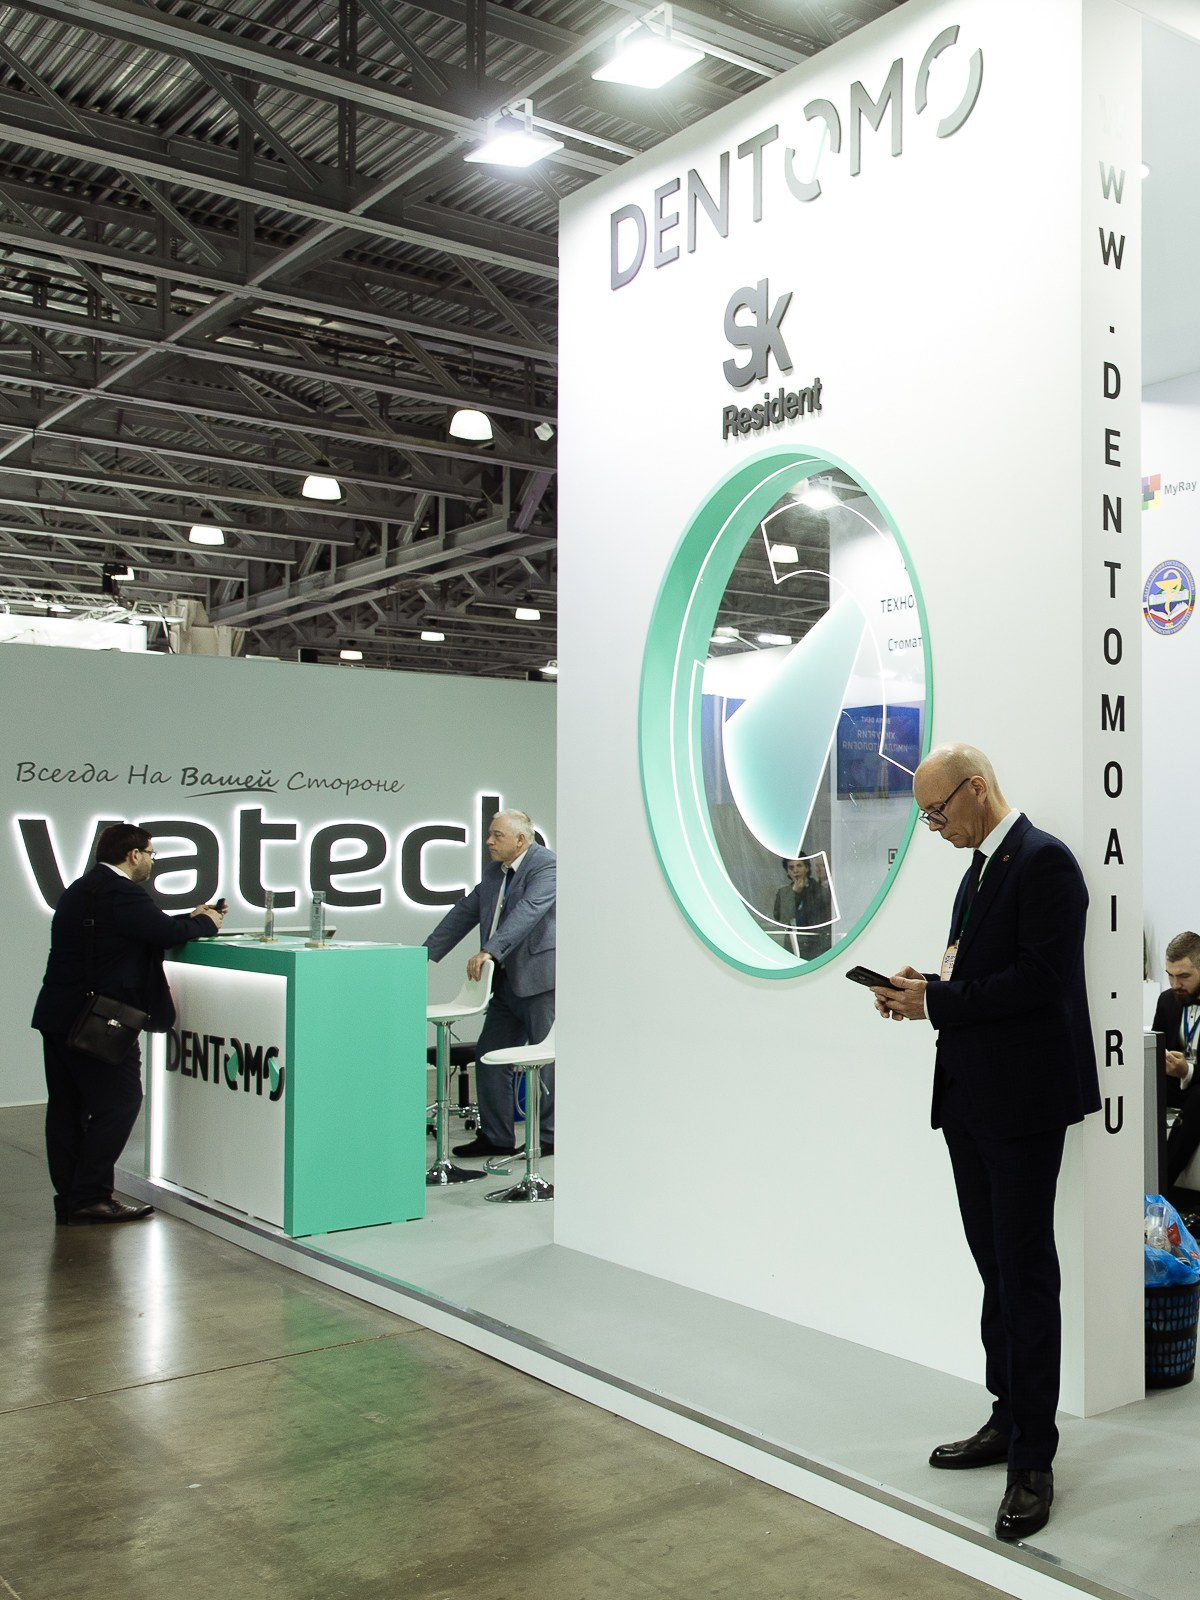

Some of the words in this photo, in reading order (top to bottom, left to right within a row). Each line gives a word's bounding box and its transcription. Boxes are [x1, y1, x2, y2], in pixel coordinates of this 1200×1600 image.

[611, 25, 984, 291] DENTOMO
[722, 377, 823, 440] Resident
[1163, 480, 1198, 496] MyRay
[881, 594, 916, 613] ТЕХНО
[15, 761, 119, 784] Всегда
[127, 764, 172, 786] На
[180, 766, 281, 789] Вашей
[286, 771, 405, 796] Стороне
[165, 1027, 285, 1102] DENTOMO
